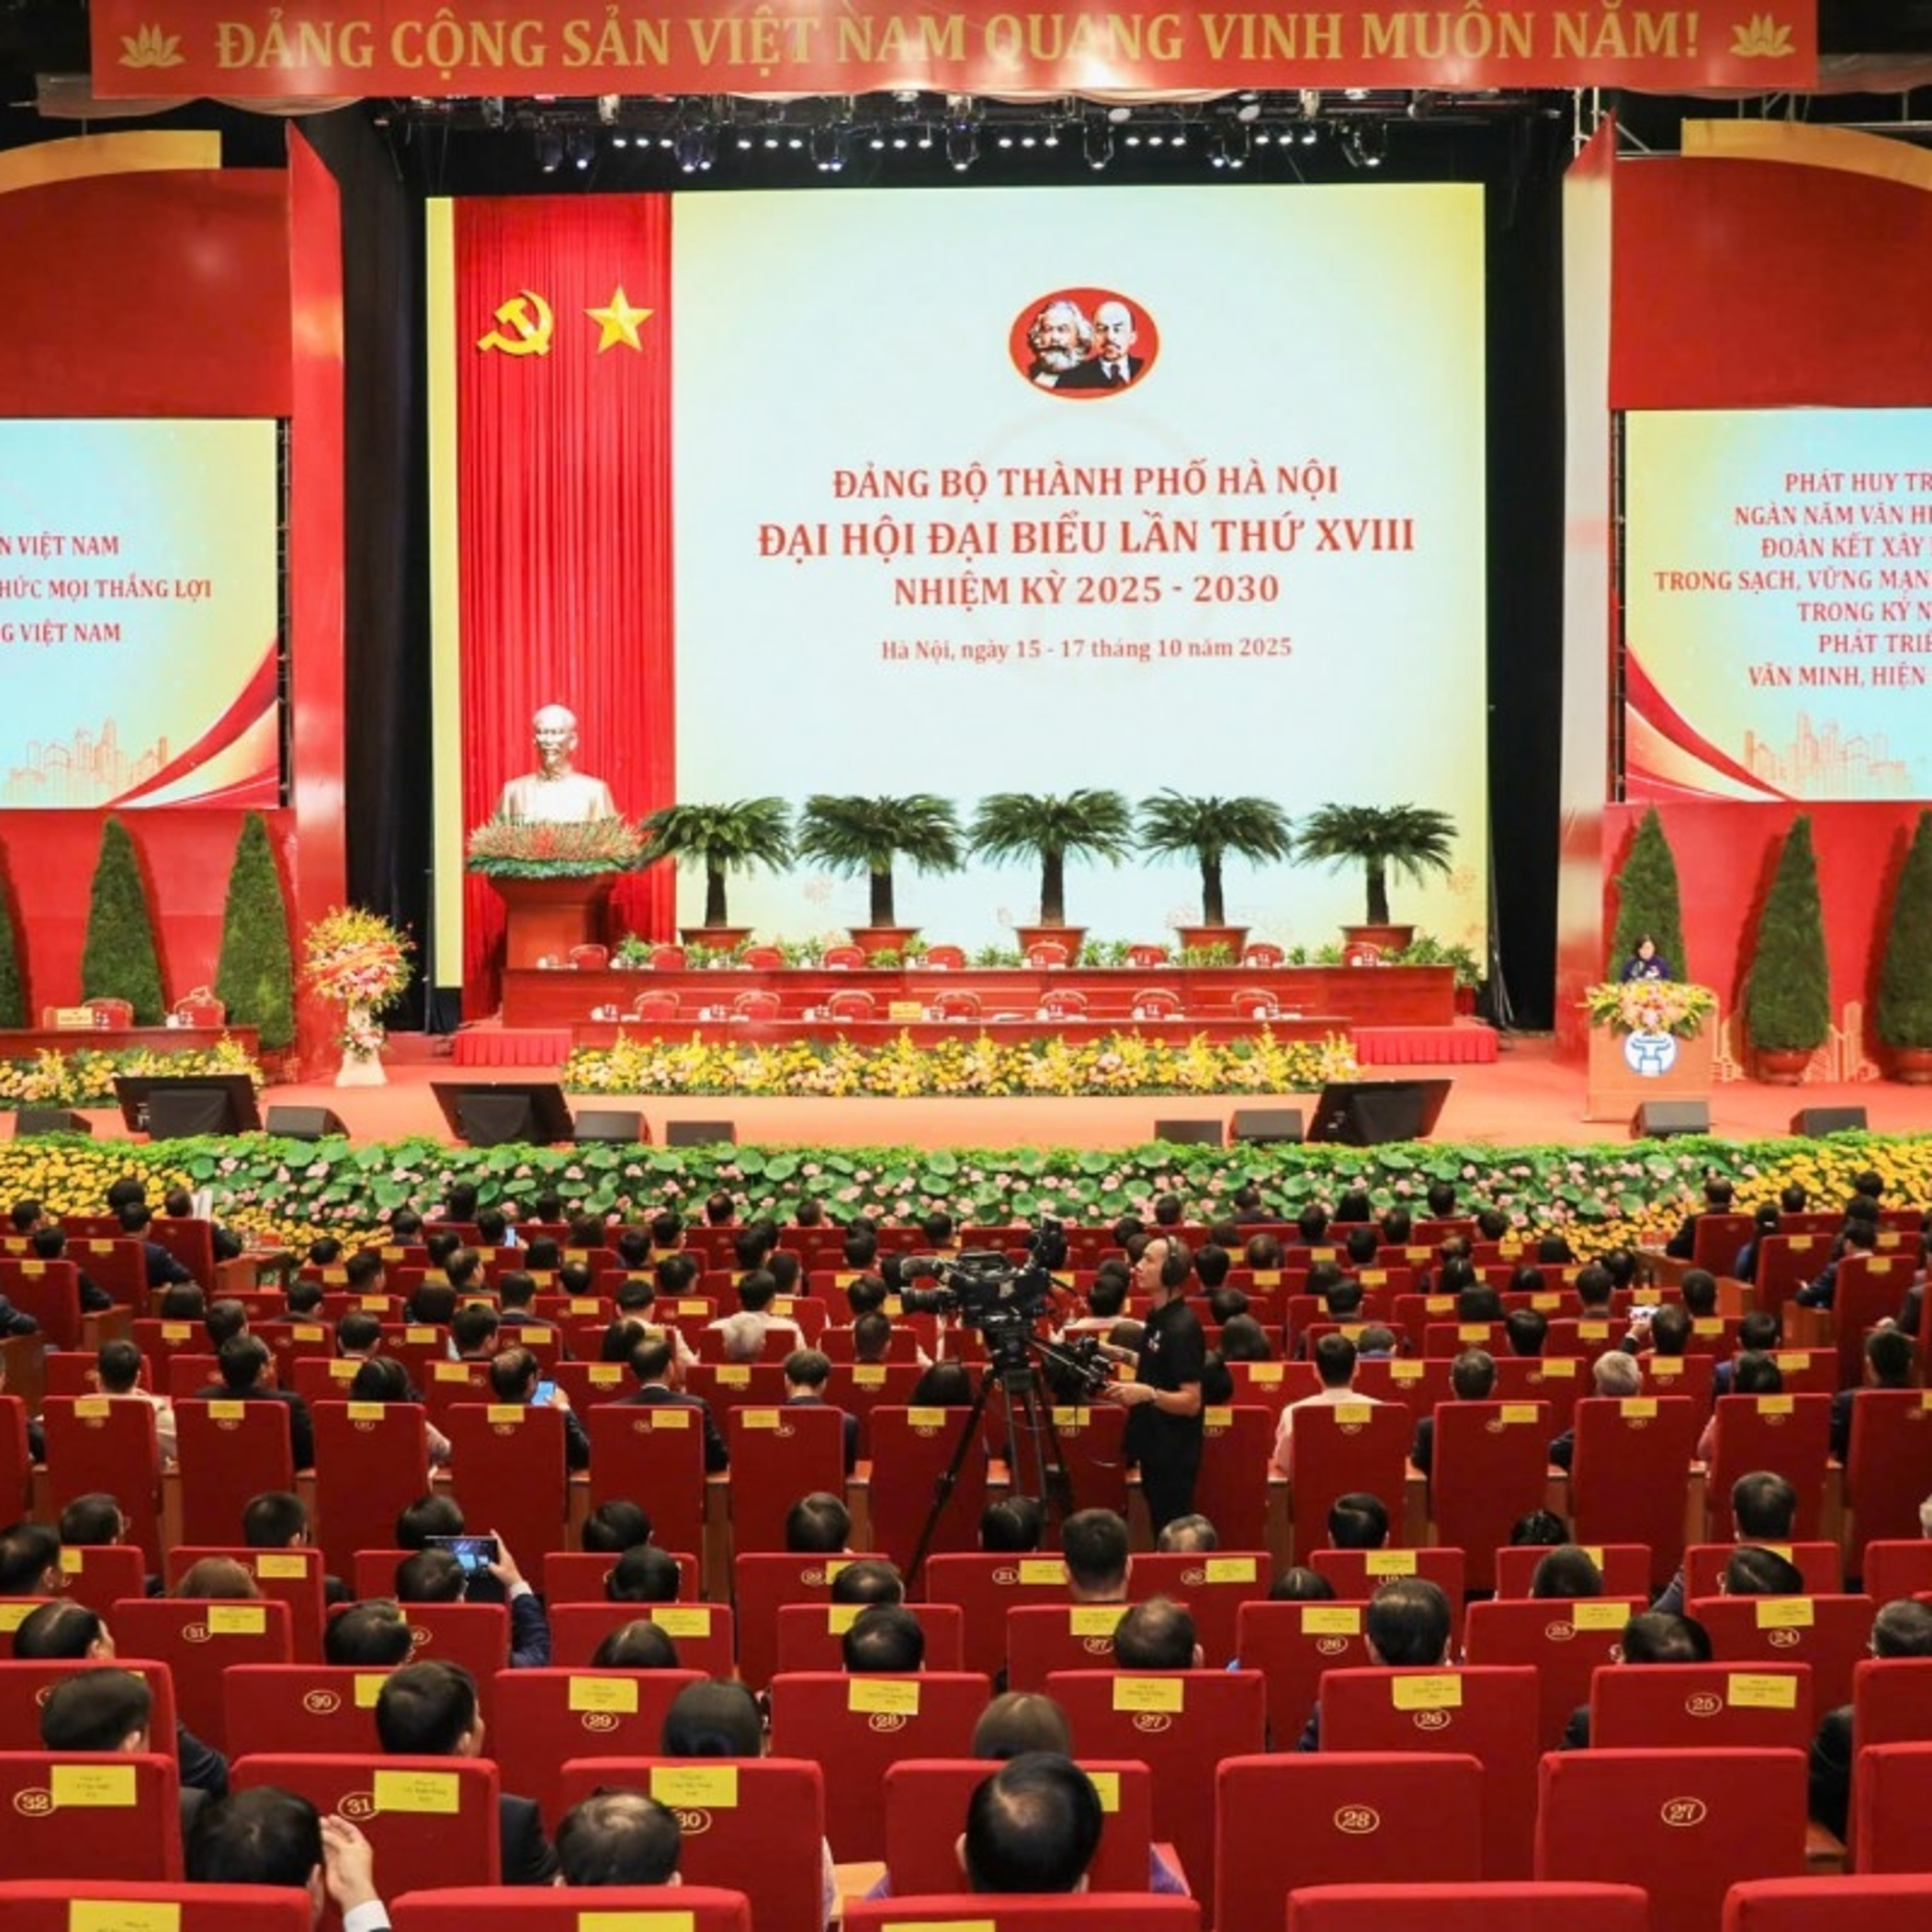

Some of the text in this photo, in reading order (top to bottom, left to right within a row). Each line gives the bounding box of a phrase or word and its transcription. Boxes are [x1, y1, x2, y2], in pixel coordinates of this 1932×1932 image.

[215, 0, 1699, 80] ĐẢNG CỘNG SẢN VIỆT NAM QUANG VINH MUÔN NĂM!
[833, 459, 1337, 504] ĐẢNG BỘ THÀNH PHỐ HÀ NỘI
[1786, 469, 1845, 493] PHÁT
[1852, 473, 1899, 493] HUY
[1736, 504, 1797, 526] NGÀN
[1805, 503, 1854, 525] NĂM
[1861, 503, 1904, 525] VĂN
[18, 532, 66, 560] VIỆT
[73, 536, 119, 556] NAM
[758, 509, 1414, 565] ĐẠI HỘI ĐẠI BIỂU LẦN THỨ XVIII
[1762, 533, 1924, 558] ĐOÀN KẾT XÂY
[0, 574, 211, 603] HỨC MỌI THẮNG LỢI
[896, 571, 1009, 612] NHIỆM
[1022, 569, 1066, 605] KỲ
[1077, 577, 1162, 604] 2025
[1195, 576, 1279, 603] 2030
[1655, 572, 1732, 591] TRONG
[1739, 571, 1801, 595] SẠCH,
[1808, 566, 1873, 590] VỮNG
[1797, 603, 1875, 622] TRONG
[21, 620, 68, 647] VIỆT
[75, 624, 120, 642] NAM
[1820, 631, 1879, 654] PHÁT
[883, 642, 909, 660] Hà
[916, 641, 955, 663] Nội,
[961, 641, 1010, 665] ngày
[1018, 640, 1041, 658] 15
[1063, 640, 1085, 658] 17
[1092, 639, 1151, 663] tháng
[1160, 639, 1182, 658] 10
[1189, 640, 1233, 658] năm
[1240, 638, 1293, 658] 2025
[1749, 662, 1926, 691] VĂN MINH, HIỆN
[1692, 1697, 1713, 1710] 25
[1141, 1714, 1163, 1727] 27
[22, 1794, 48, 1810] 32
[347, 1799, 370, 1814] 31
[1670, 1804, 1696, 1820] 27
[1344, 1811, 1370, 1828] 28
